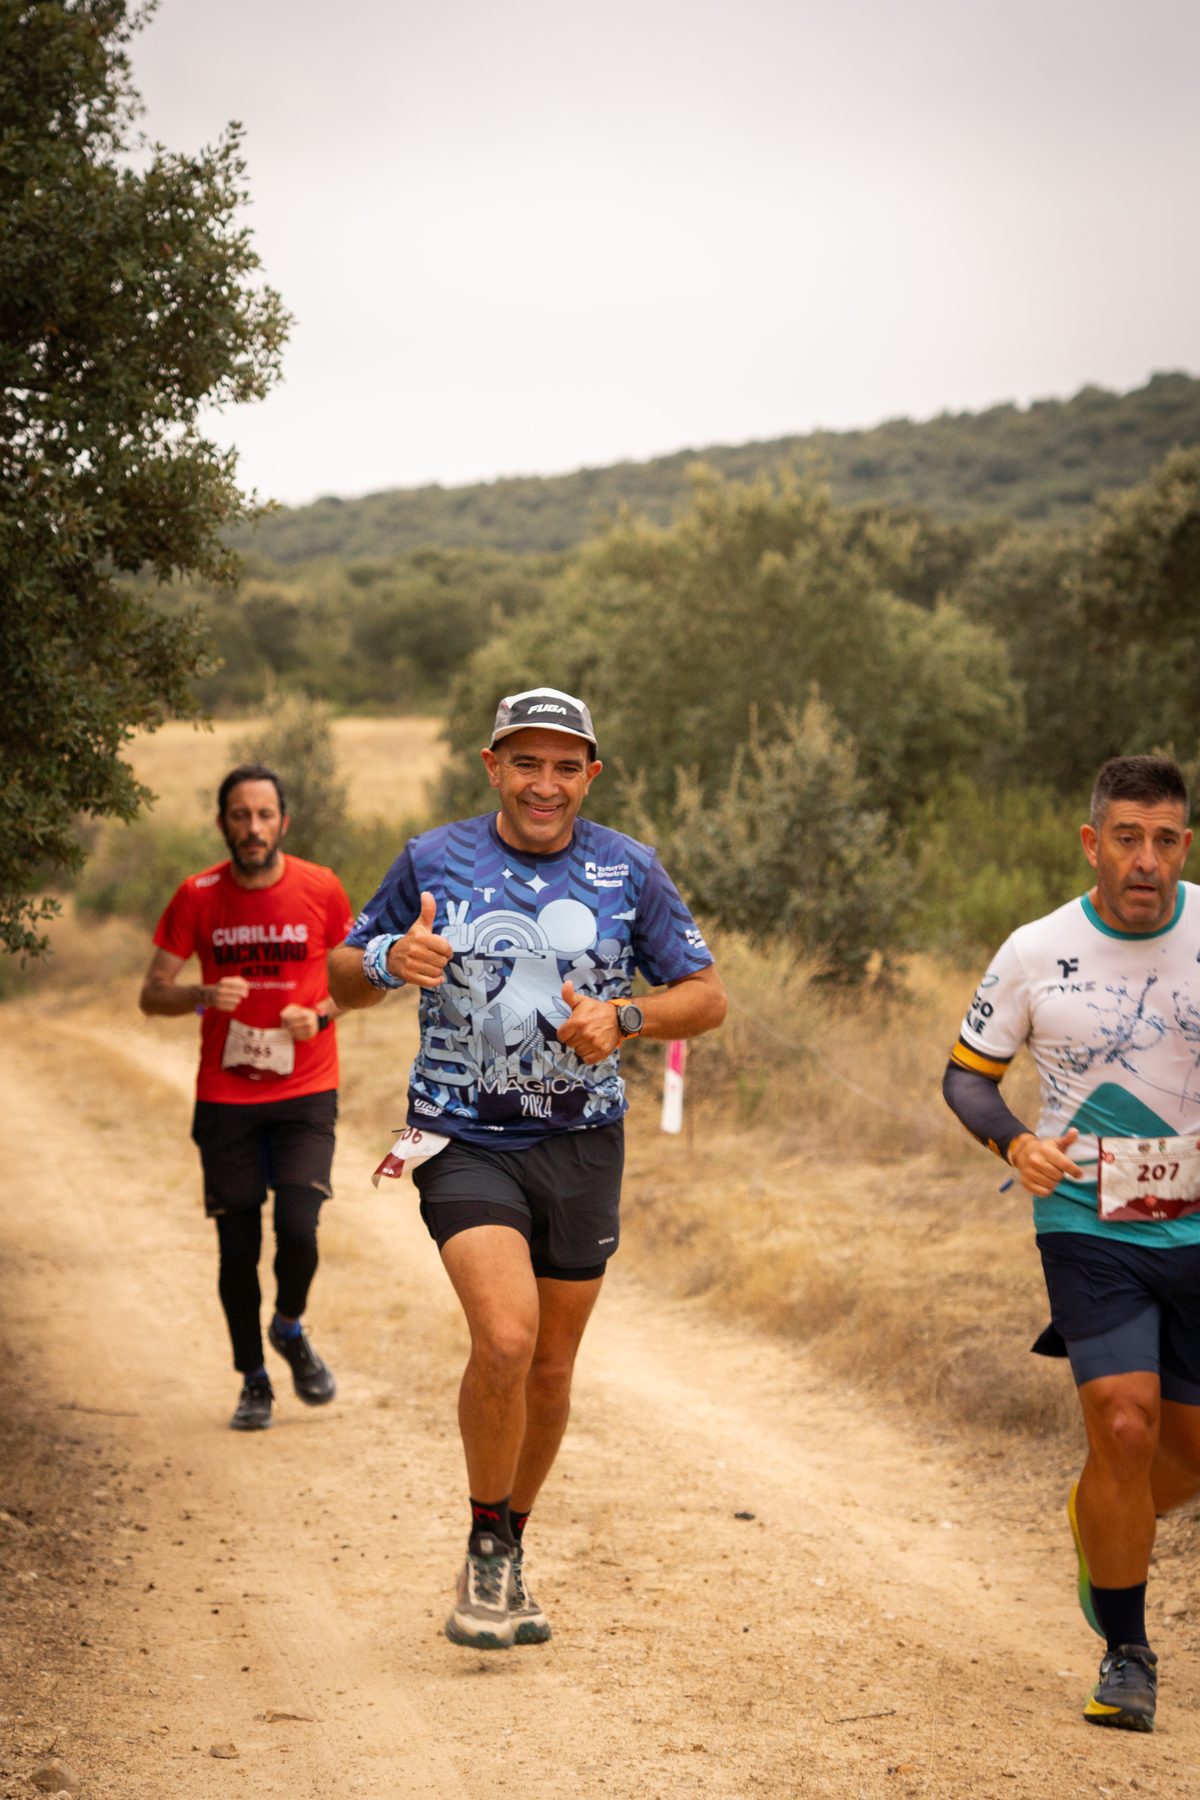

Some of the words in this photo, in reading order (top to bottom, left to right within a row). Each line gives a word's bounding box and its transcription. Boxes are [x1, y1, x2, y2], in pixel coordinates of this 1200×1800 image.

[527, 704, 567, 715] FUGA
[212, 924, 308, 946] CURILLAS
[214, 942, 307, 965] BACKYARD
[520, 1094, 553, 1119] 2024
[1137, 1162, 1180, 1182] 207
